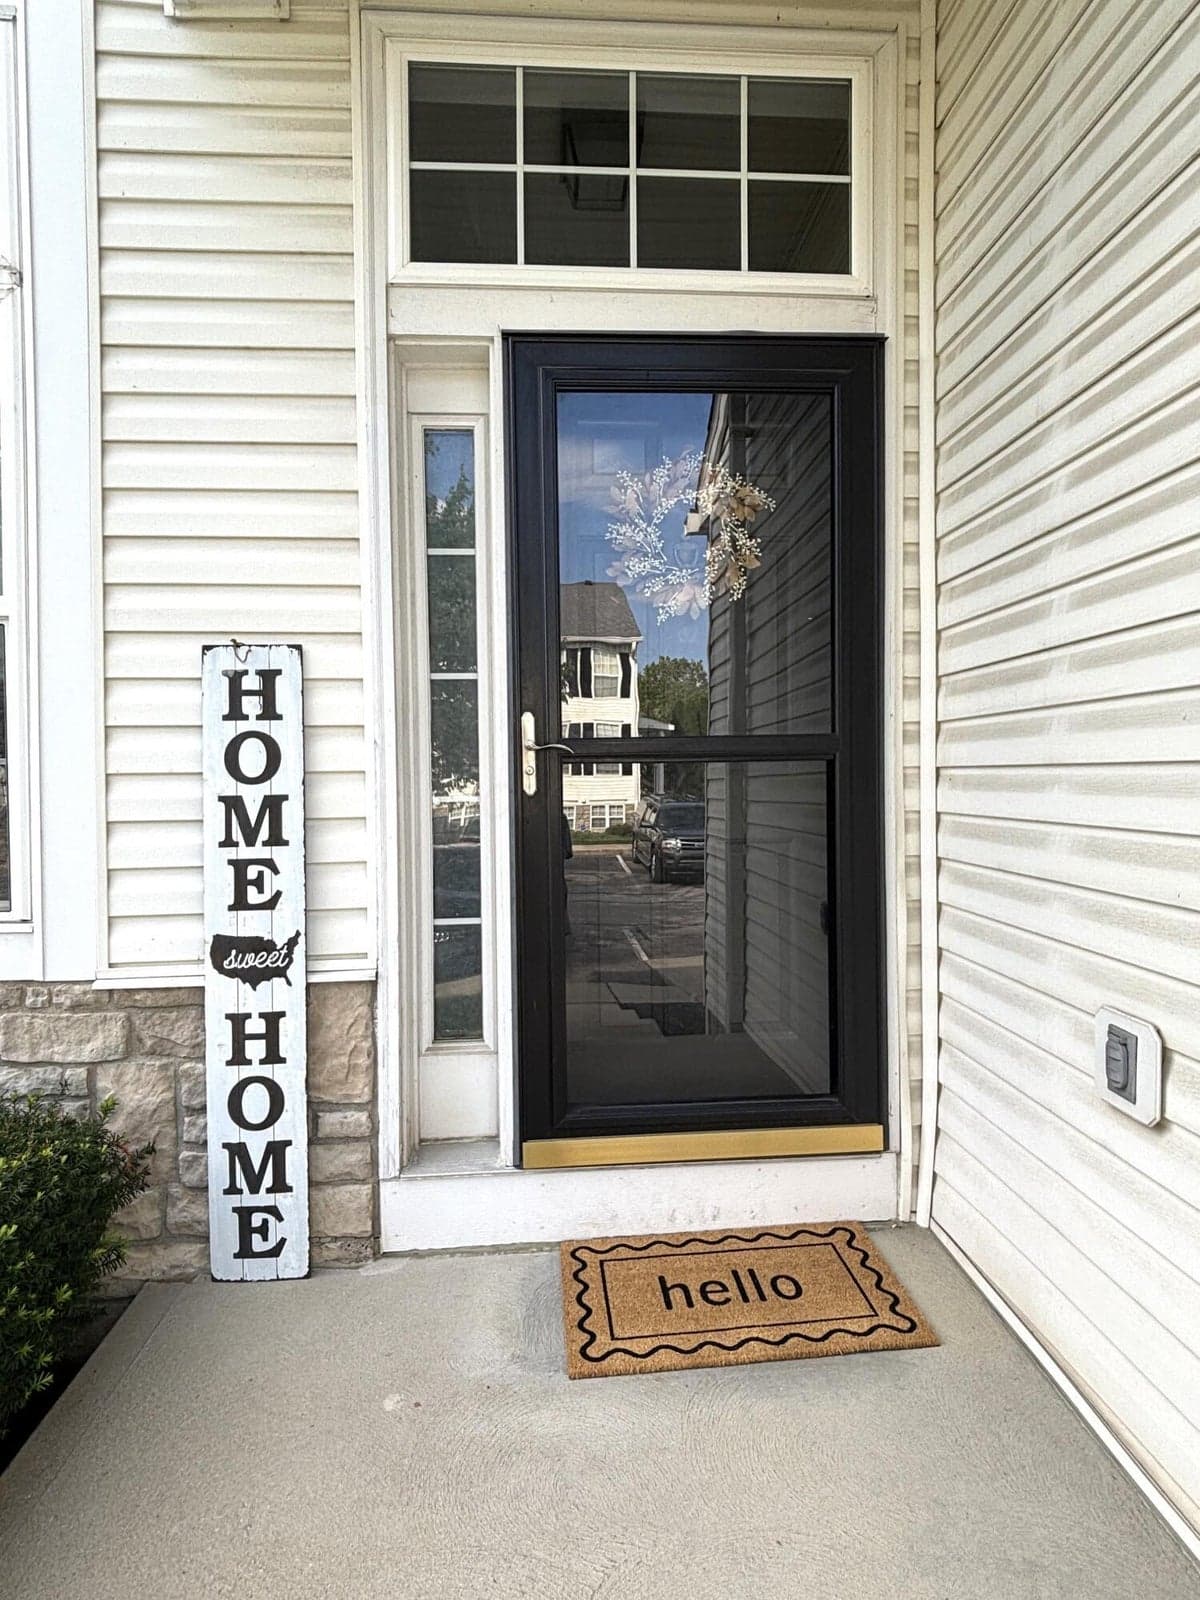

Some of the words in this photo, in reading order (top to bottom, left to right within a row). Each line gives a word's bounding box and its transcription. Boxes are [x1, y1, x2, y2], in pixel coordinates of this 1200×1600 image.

[218, 668, 290, 911] HOME
[223, 945, 289, 969] sweet
[222, 1011, 294, 1260] HOME
[657, 1268, 803, 1311] hello
